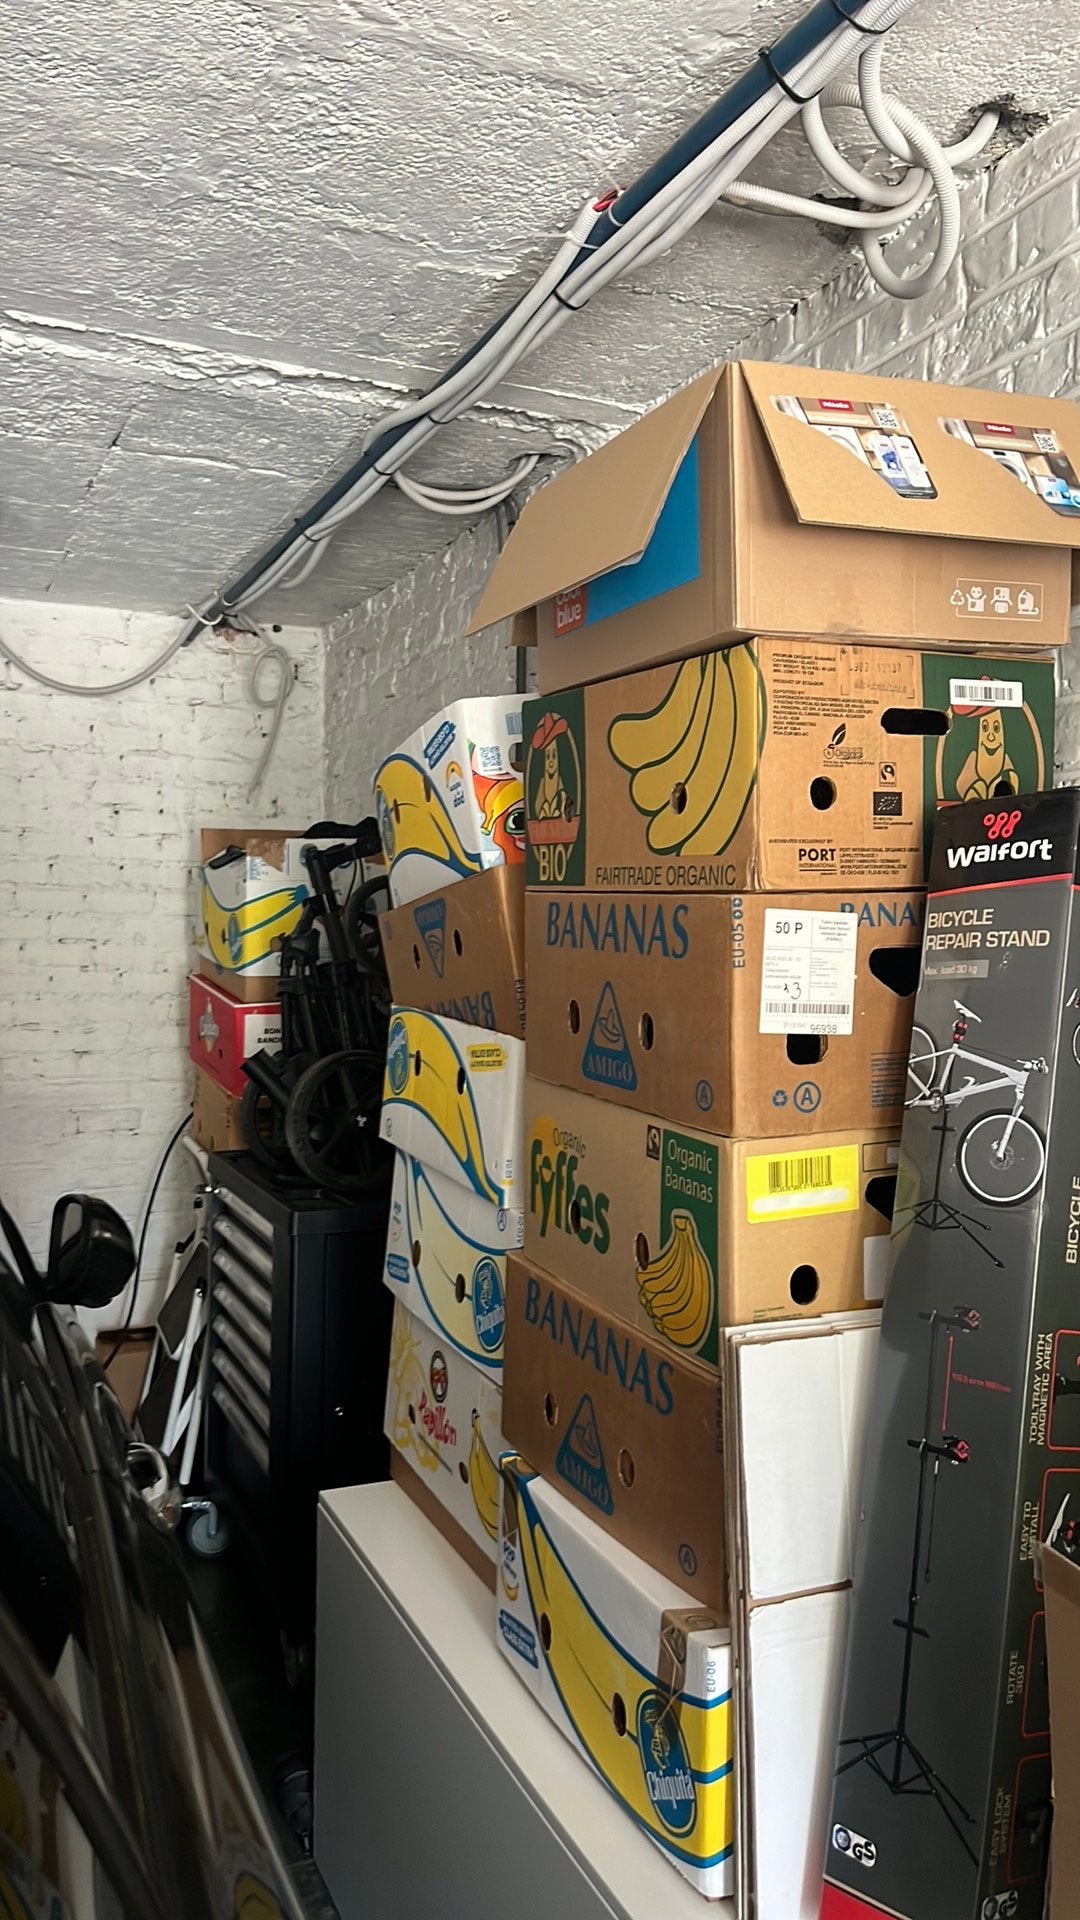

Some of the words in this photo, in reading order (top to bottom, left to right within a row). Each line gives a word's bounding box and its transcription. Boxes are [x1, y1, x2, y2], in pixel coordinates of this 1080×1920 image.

[557, 603, 581, 628] blue
[539, 844, 567, 882] BIO
[798, 848, 837, 861] PORT
[596, 864, 662, 886] FAIRTRADE
[666, 863, 737, 886] ORGANIC
[545, 901, 690, 960] BANANAS
[775, 921, 790, 934] 50
[794, 921, 803, 934] P
[927, 908, 994, 928] BICYCLE
[731, 923, 746, 969] EU-05
[925, 932, 982, 950] REPAIR
[985, 929, 1050, 948] STAND
[956, 964, 967, 974] 30
[810, 1023, 838, 1034] 96938
[586, 1053, 632, 1084] AMIGO
[553, 1127, 586, 1159] Organic
[668, 1138, 713, 1175] Organic
[530, 1138, 611, 1255] fyffes
[665, 1165, 713, 1204] Bananas
[1065, 1176, 1080, 1265] BICYCLE
[525, 1275, 675, 1417] BANANAS
[1035, 1333, 1046, 1371] WITH
[1036, 1372, 1050, 1446] MAGNETIC
[1043, 1332, 1054, 1370] AREA
[1029, 1373, 1042, 1444] TOOLTRAY
[562, 1453, 609, 1506] AMIGO
[1022, 1501, 1032, 1521] TO
[1019, 1524, 1030, 1561] EASY
[1006, 1650, 1019, 1705] ROTATE
[646, 1767, 695, 1810] Chiquita
[852, 1840, 875, 1861] GS
